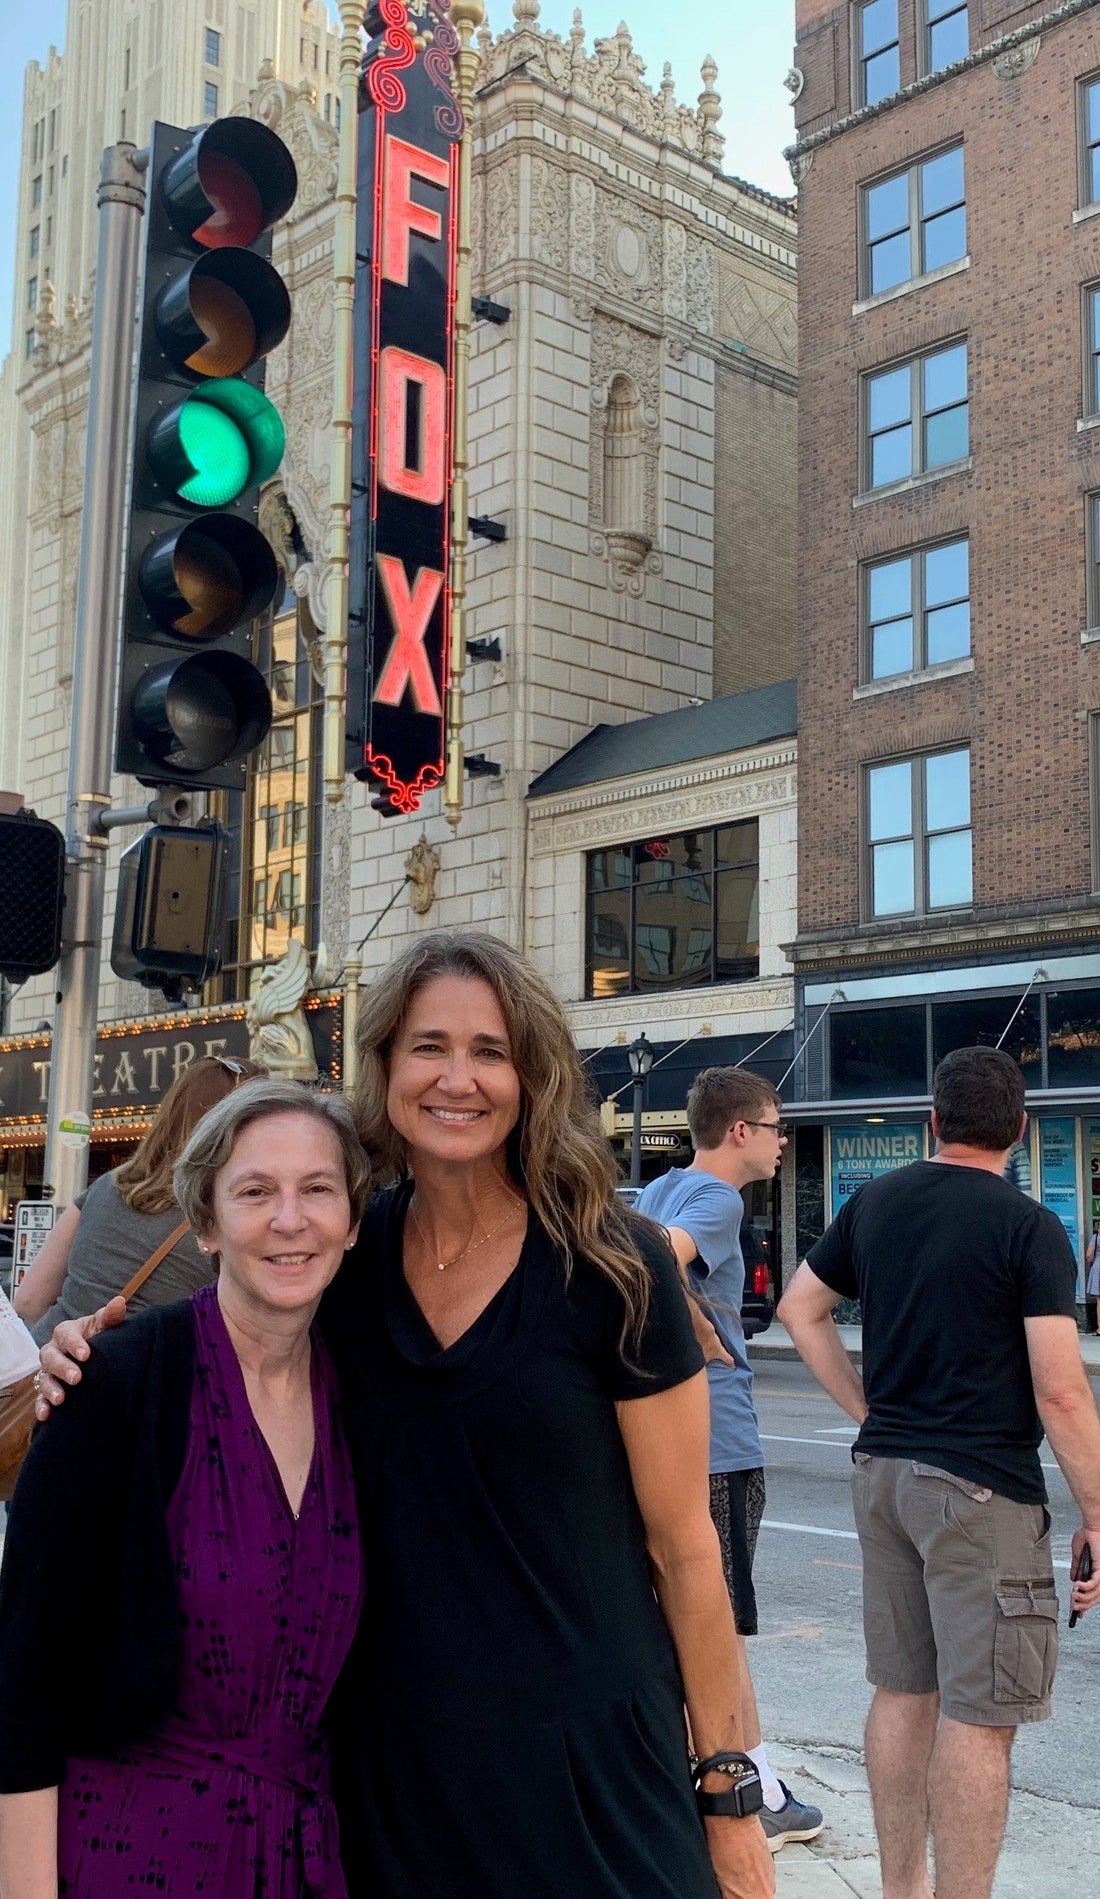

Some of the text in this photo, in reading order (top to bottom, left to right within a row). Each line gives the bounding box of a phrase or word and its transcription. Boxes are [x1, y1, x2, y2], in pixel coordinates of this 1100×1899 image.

[373, 134, 452, 717] FOX
[32, 1037, 228, 1103] TEATR
[837, 1136, 918, 1158] WINNER
[845, 1160, 873, 1170] TONY
[874, 1158, 918, 1169] AWARD
[838, 1183, 860, 1195] BES
